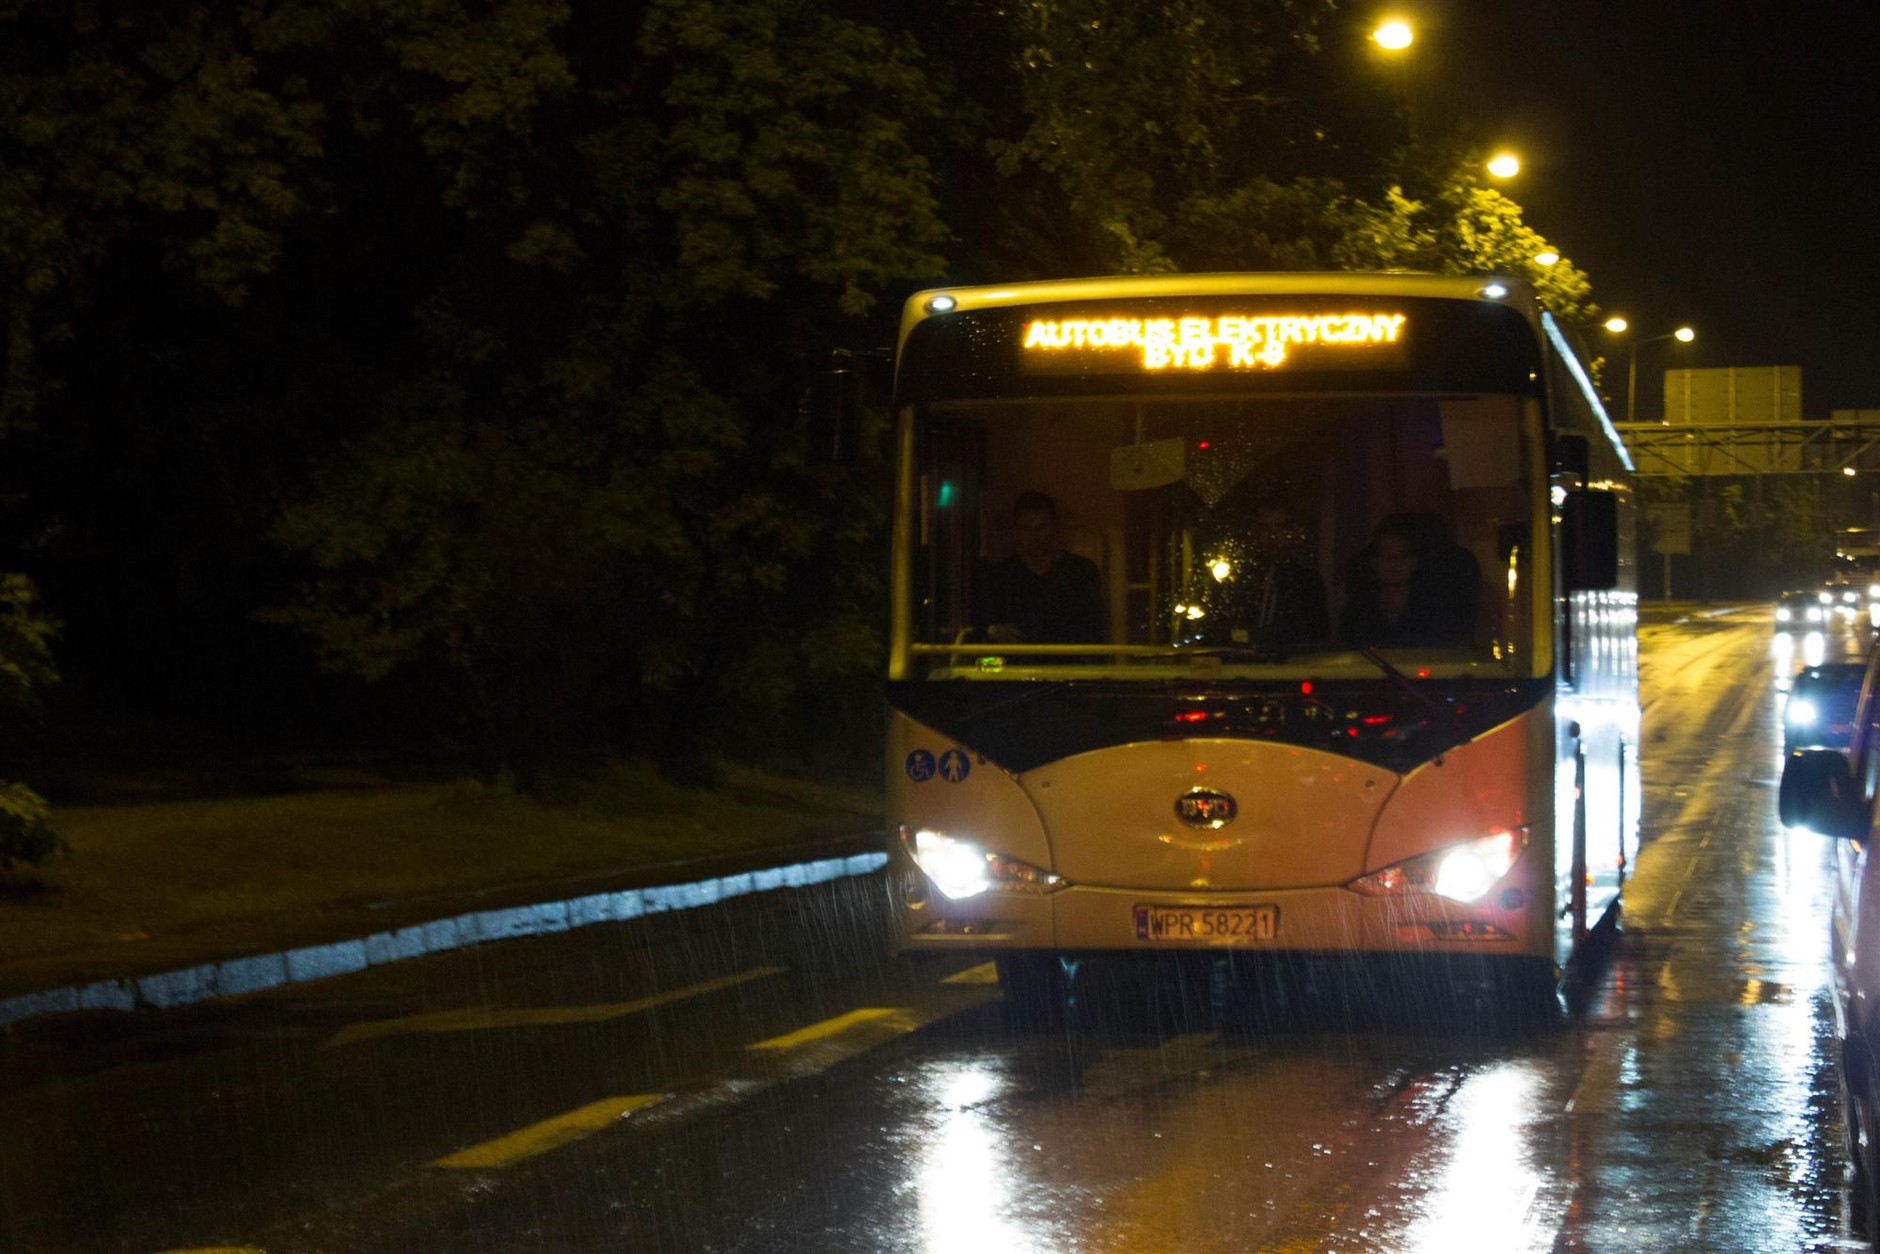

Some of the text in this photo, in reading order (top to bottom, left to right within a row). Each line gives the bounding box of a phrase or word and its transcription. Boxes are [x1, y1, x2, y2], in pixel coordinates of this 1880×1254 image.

[1025, 315, 1404, 347] AUTOBUS ELEKTRYCZNY
[1144, 342, 1214, 368] BYD
[1149, 912, 1194, 936] WPR
[1202, 912, 1269, 936] 58221
